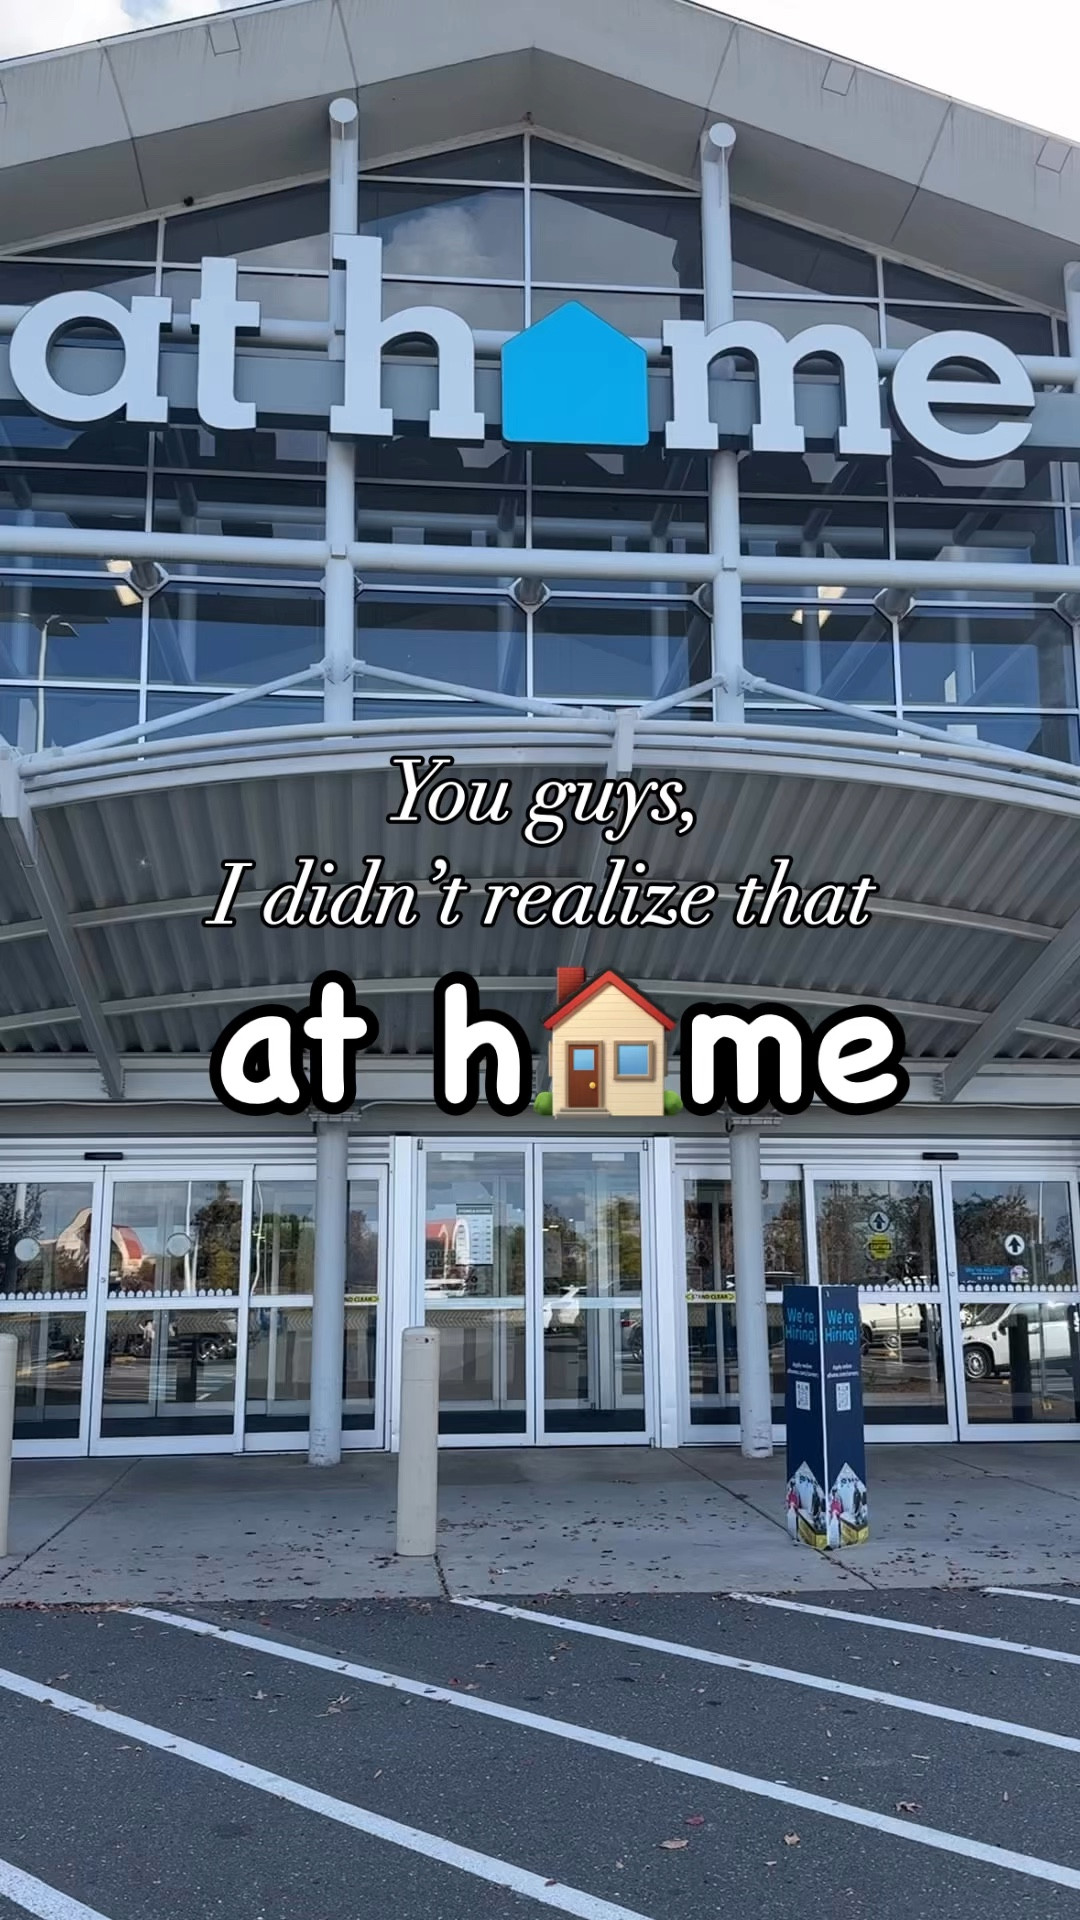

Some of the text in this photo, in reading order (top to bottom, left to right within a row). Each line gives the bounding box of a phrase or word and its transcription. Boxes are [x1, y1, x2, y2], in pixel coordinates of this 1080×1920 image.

[8, 232, 1036, 465] at hme
[786, 1307, 815, 1324] We're
[826, 1308, 854, 1325] We're
[785, 1325, 818, 1345] Hiring!
[824, 1325, 858, 1345] Hiring!
